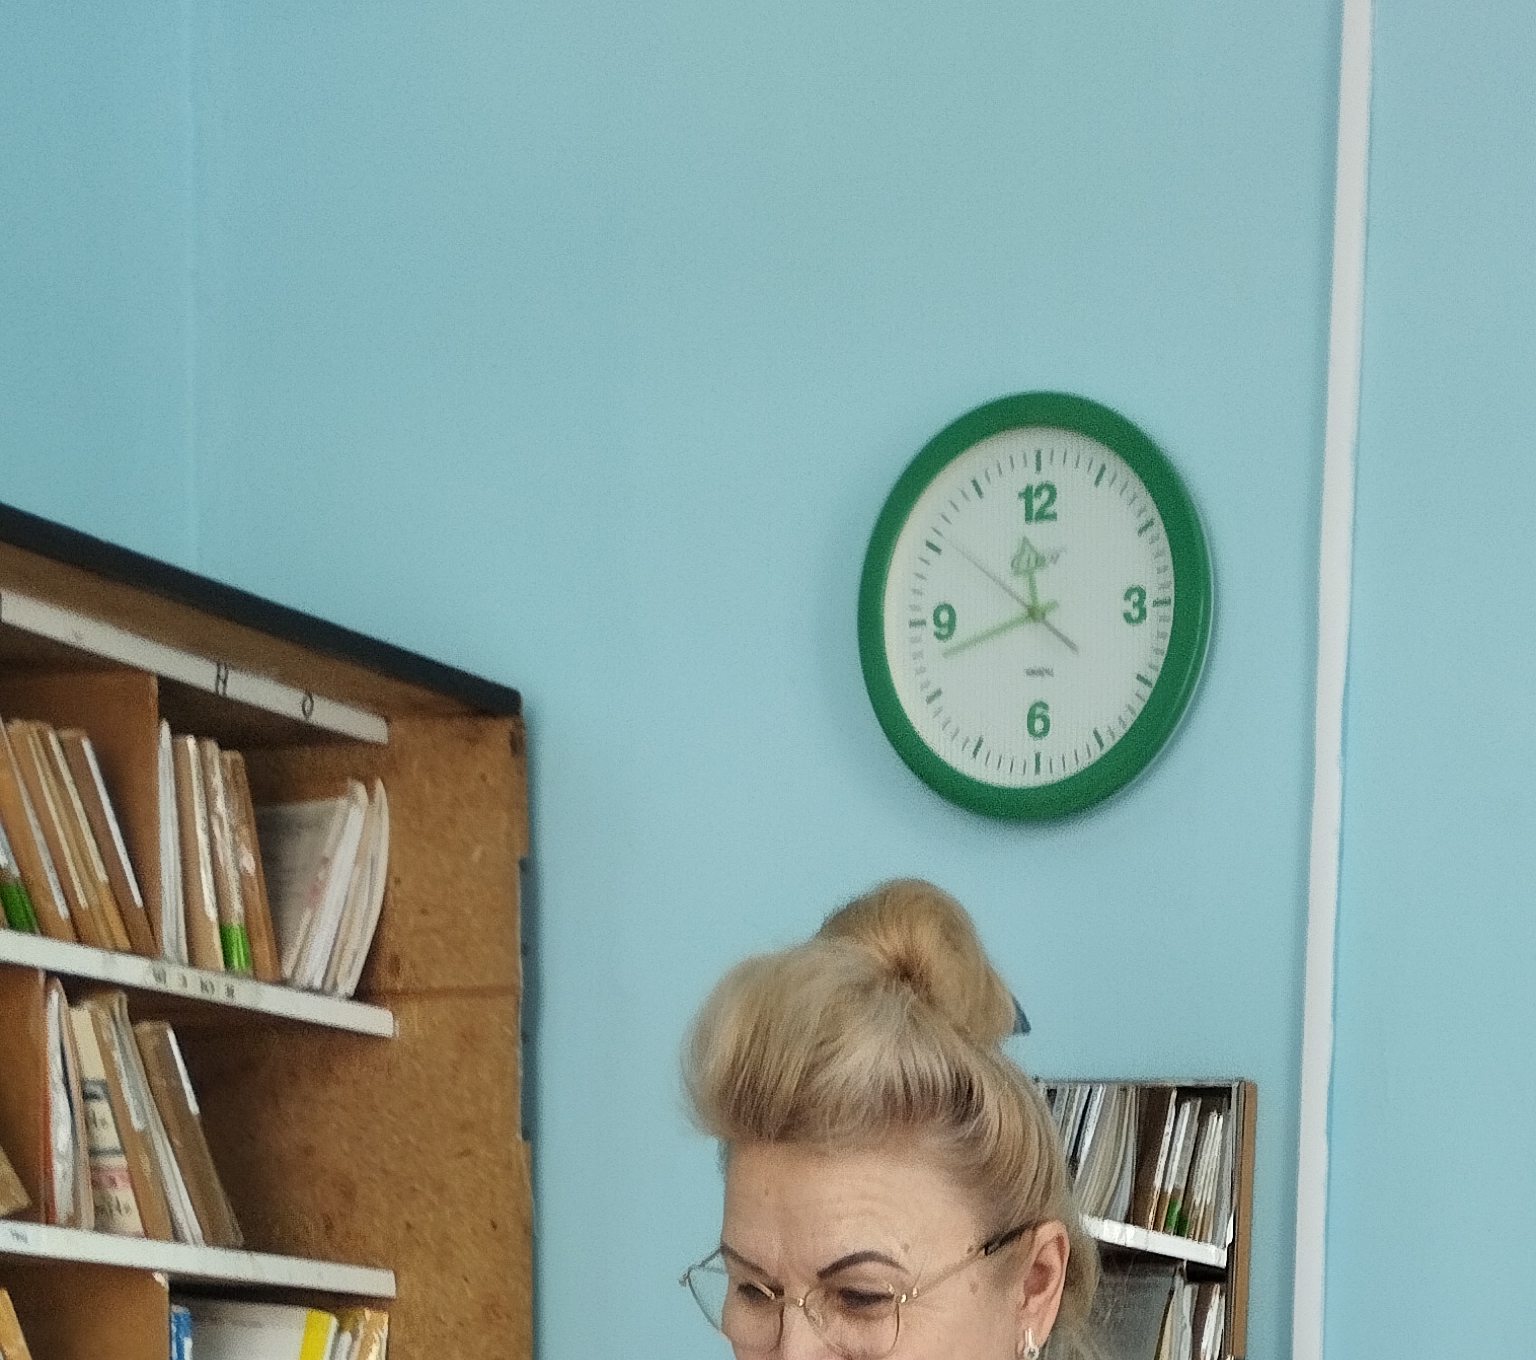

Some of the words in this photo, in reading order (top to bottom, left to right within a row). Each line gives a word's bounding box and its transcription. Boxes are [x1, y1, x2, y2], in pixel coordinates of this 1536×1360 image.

[1018, 481, 1058, 524] 12
[932, 602, 957, 641] 9
[1122, 584, 1147, 626] 3
[1026, 700, 1051, 739] 6
